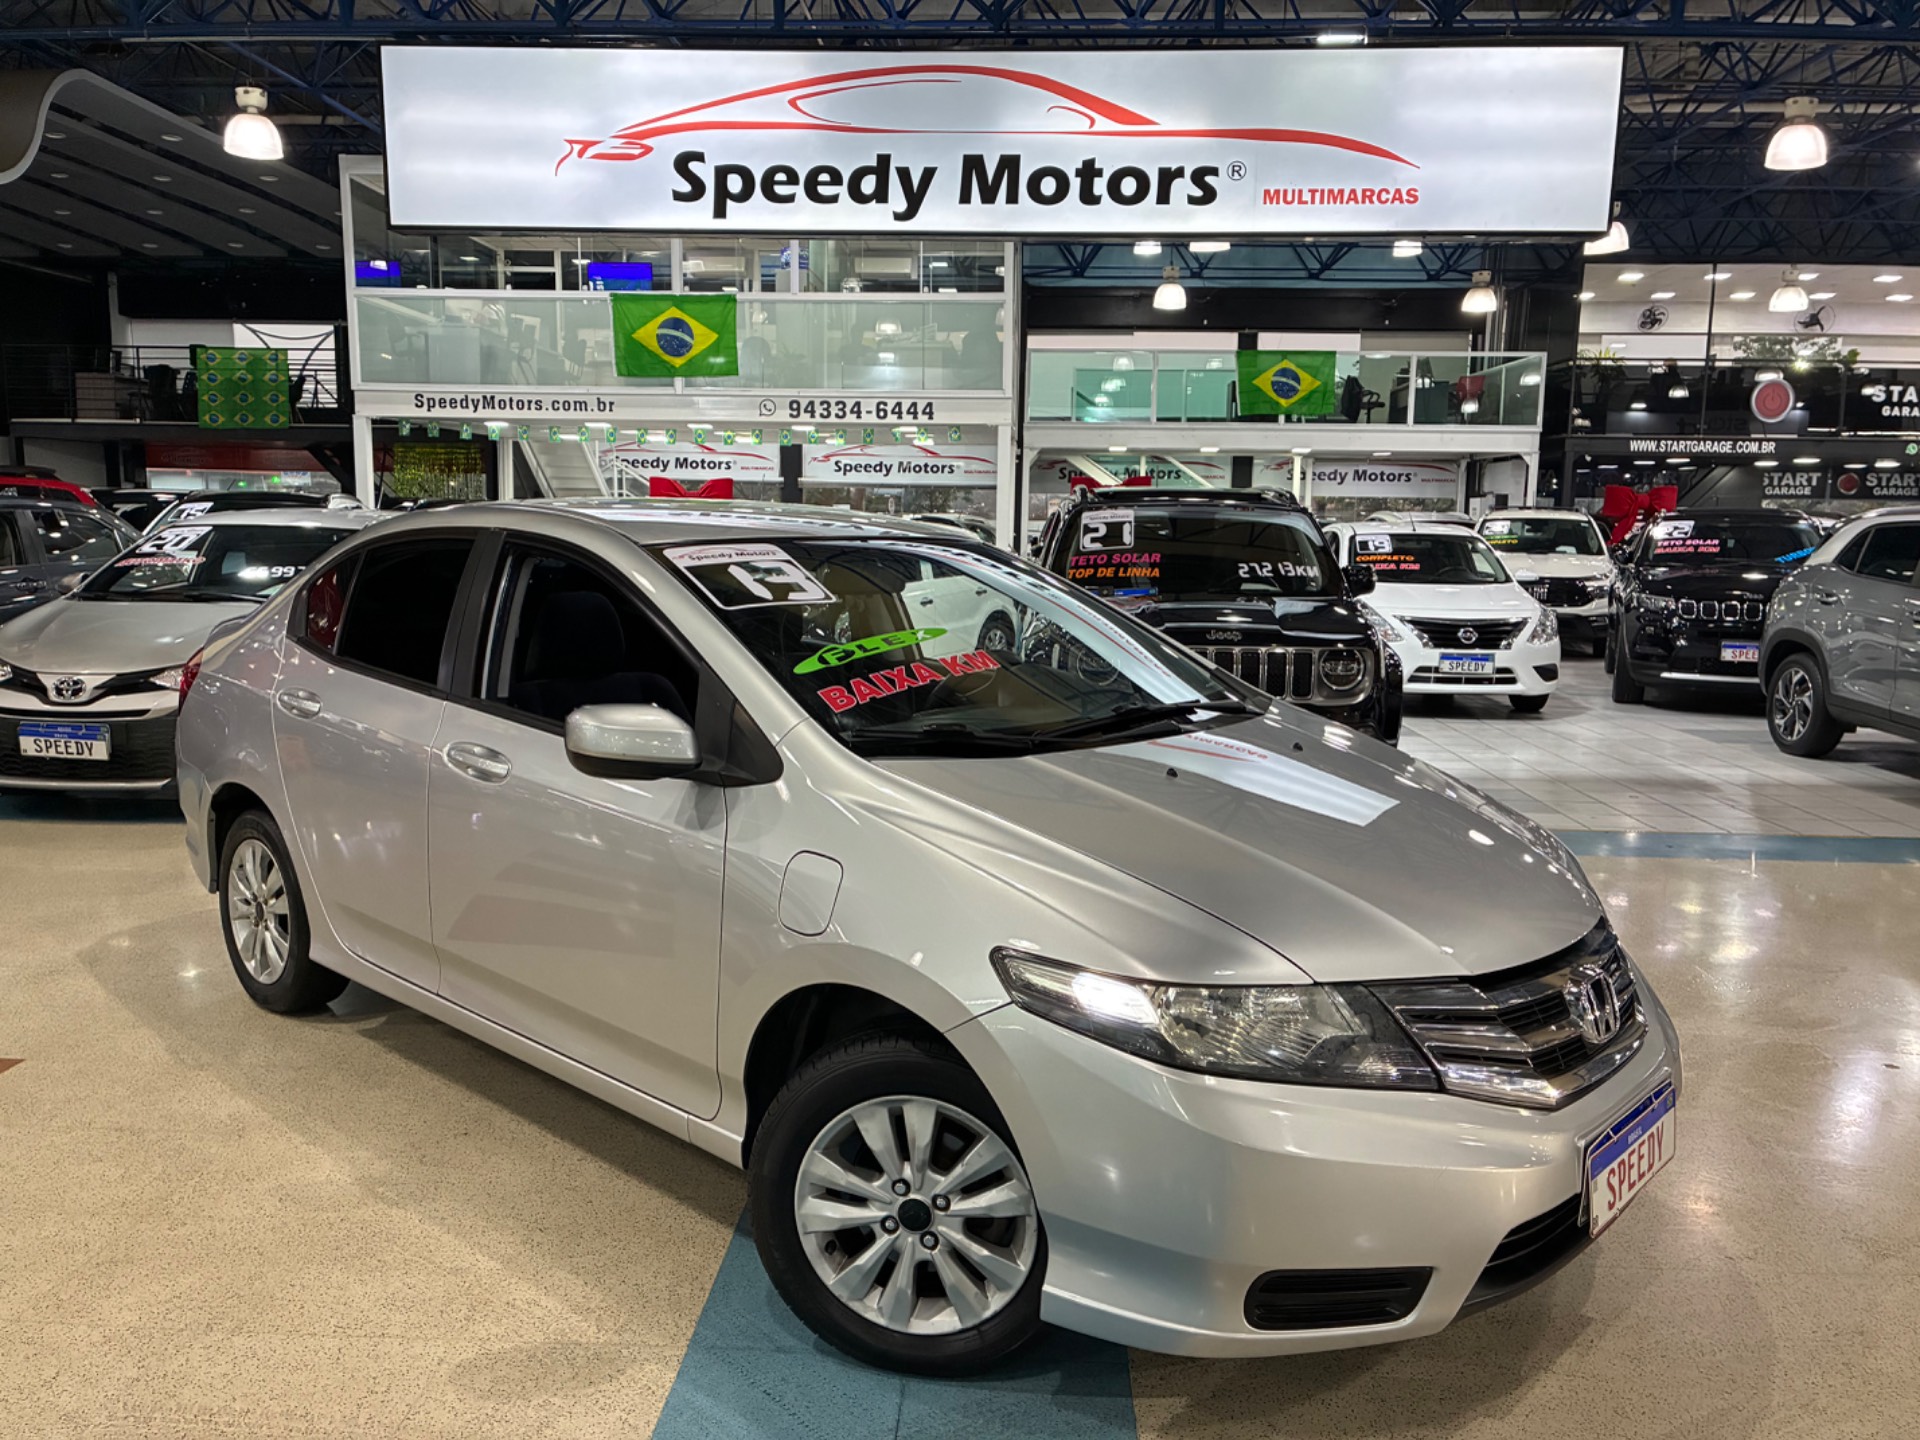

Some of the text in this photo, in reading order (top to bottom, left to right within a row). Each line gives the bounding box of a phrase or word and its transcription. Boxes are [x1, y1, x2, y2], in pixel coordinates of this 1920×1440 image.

[672, 150, 938, 222] Speedy
[1262, 187, 1420, 205] MULTIMARCAS
[414, 393, 615, 413] SpeedyMotors.com.br
[788, 399, 935, 420] 94334-6444
[1630, 440, 1777, 455] WWW.STARTGARAGE.COM.BR
[675, 457, 733, 471] Motors
[834, 460, 956, 477] Speedy Motors
[1353, 469, 1413, 483] Motors
[1764, 486, 1813, 496] GARAGE
[1872, 487, 1920, 496] GARAGE
[1082, 522, 1132, 549] 21
[1070, 552, 1162, 567] TETO SOLAR
[1067, 566, 1161, 580] TOP DE LINHA
[1448, 660, 1487, 672] SPEEDY
[817, 650, 1001, 713] BAIXA KM
[33, 738, 94, 757] SPEEDY
[1607, 1120, 1665, 1212] SPEEDY
